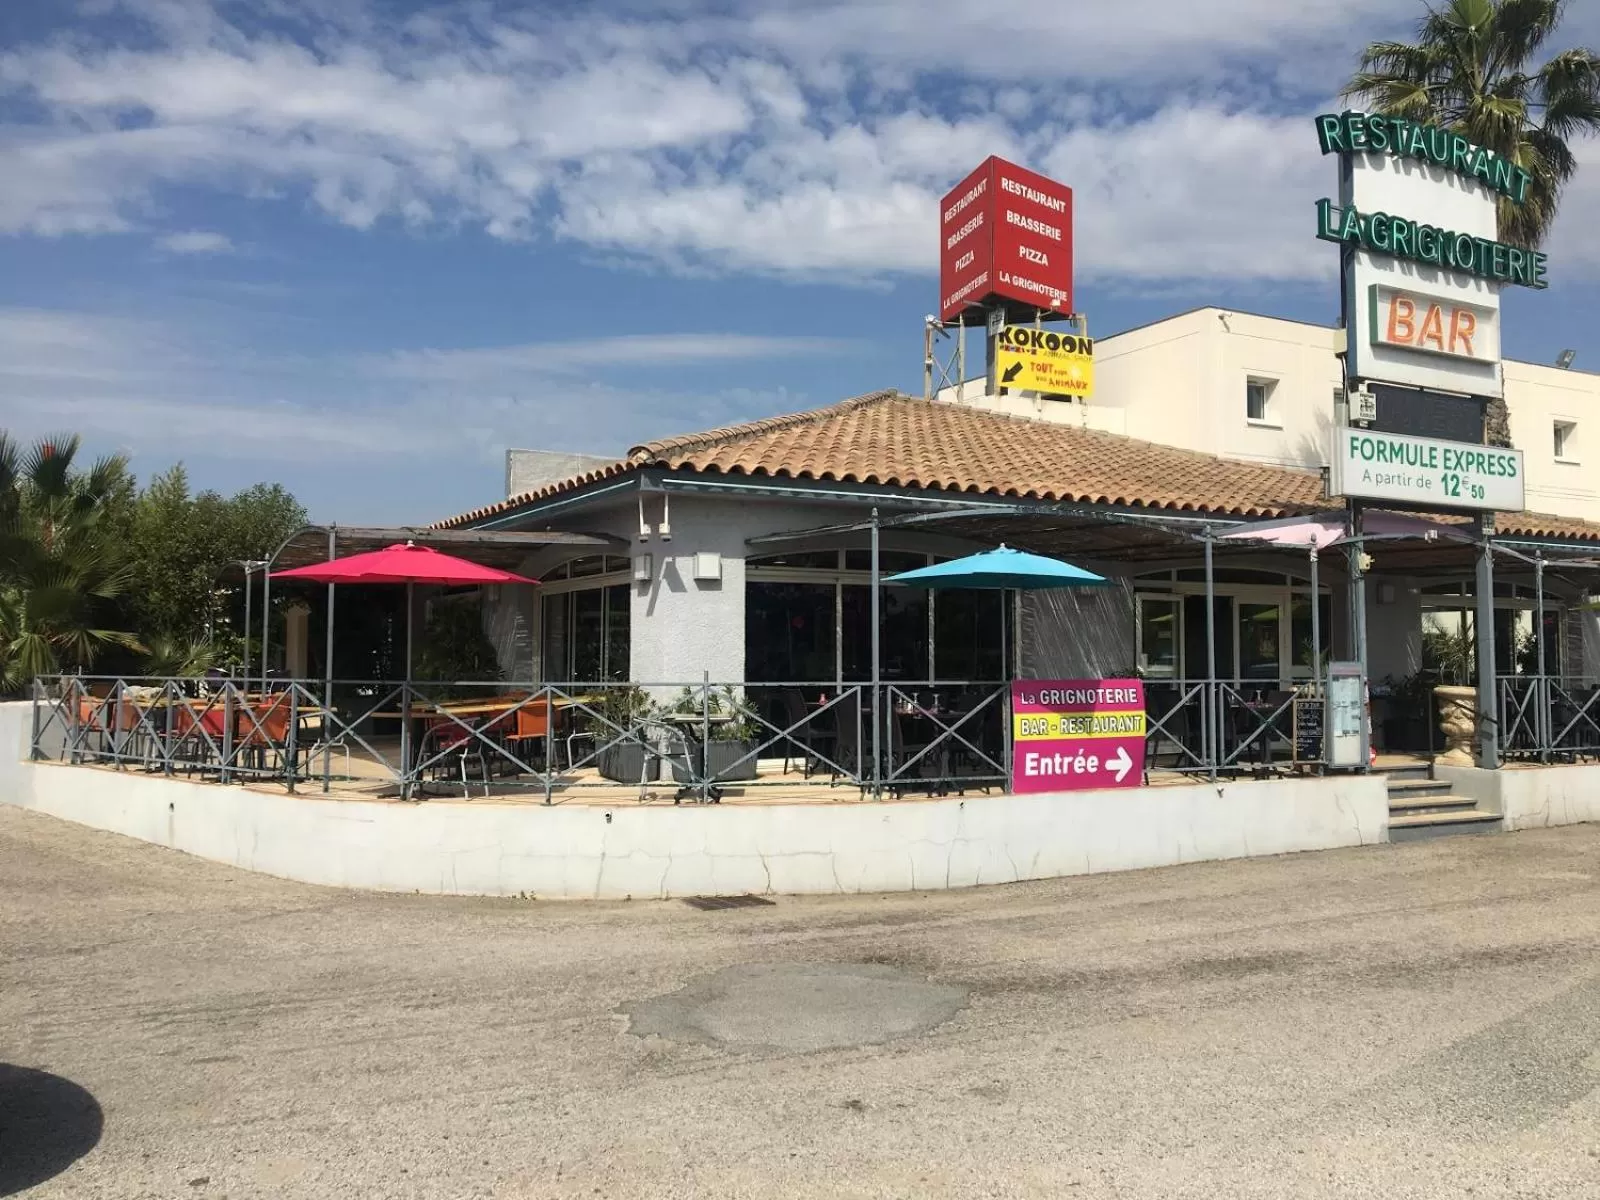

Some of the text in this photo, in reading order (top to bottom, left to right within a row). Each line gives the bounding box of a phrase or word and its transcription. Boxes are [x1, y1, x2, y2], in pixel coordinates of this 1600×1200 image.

[1315, 110, 1533, 205] RESTAURANT
[945, 178, 987, 224] RESTAURANT
[1001, 177, 1066, 213] RESTAURANT
[948, 211, 984, 250] BRASSERIE
[1006, 210, 1062, 241] BRASSERIE
[1019, 246, 1049, 267] PIZZA
[1315, 198, 1549, 289] LA GRIGNOTERIE
[955, 250, 975, 272] PIZZA
[944, 271, 989, 310] LA GRIGNOTERIE
[999, 271, 1068, 301] LA GRIGNOTERIE
[1386, 294, 1477, 356] BAR
[999, 327, 1093, 356] KOKOON
[1030, 362, 1054, 373] TOUT
[1350, 436, 1517, 478] FORMULE EXPRESS
[1362, 469, 1372, 483] A
[1375, 470, 1411, 488] partir
[1416, 473, 1432, 489] de
[1021, 688, 1138, 705] La GRIGNOTERIE
[1021, 718, 1048, 736] BAR
[1060, 716, 1142, 735] RESTAURANT
[1025, 748, 1099, 776] Entrée
